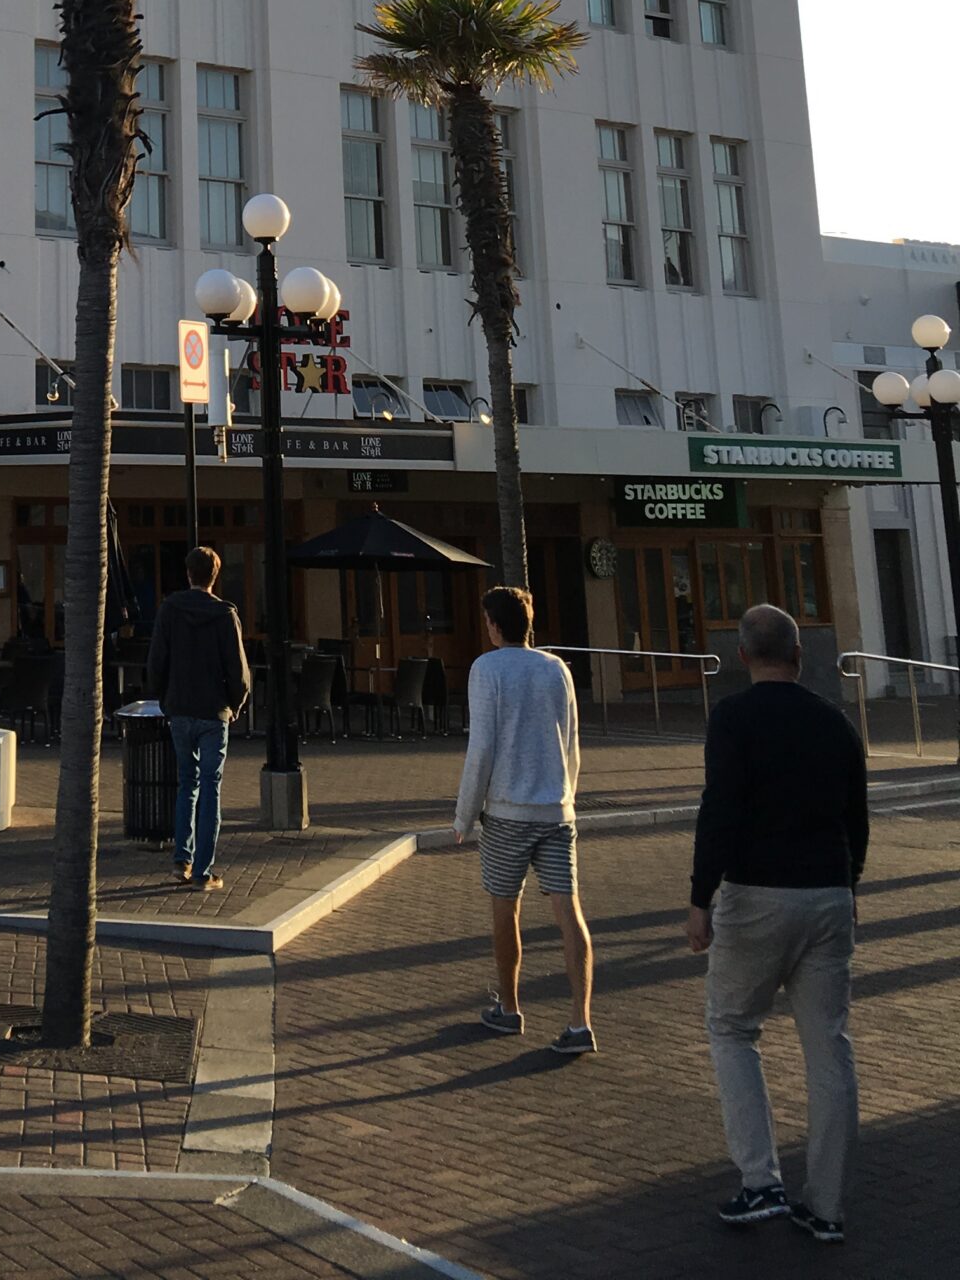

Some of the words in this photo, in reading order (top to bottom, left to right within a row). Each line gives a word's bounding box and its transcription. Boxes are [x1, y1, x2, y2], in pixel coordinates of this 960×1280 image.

[15, 437, 22, 448] &
[26, 436, 47, 447] BAR
[231, 433, 254, 444] LONE
[361, 437, 382, 447] LONE
[308, 440, 316, 450] &
[323, 440, 349, 451] BAR
[703, 444, 823, 467] STARBUCKS
[823, 449, 895, 470] COFFEE
[353, 472, 372, 482] LONE
[624, 483, 724, 501] STARBUCKS
[644, 503, 706, 520] COFFEE
